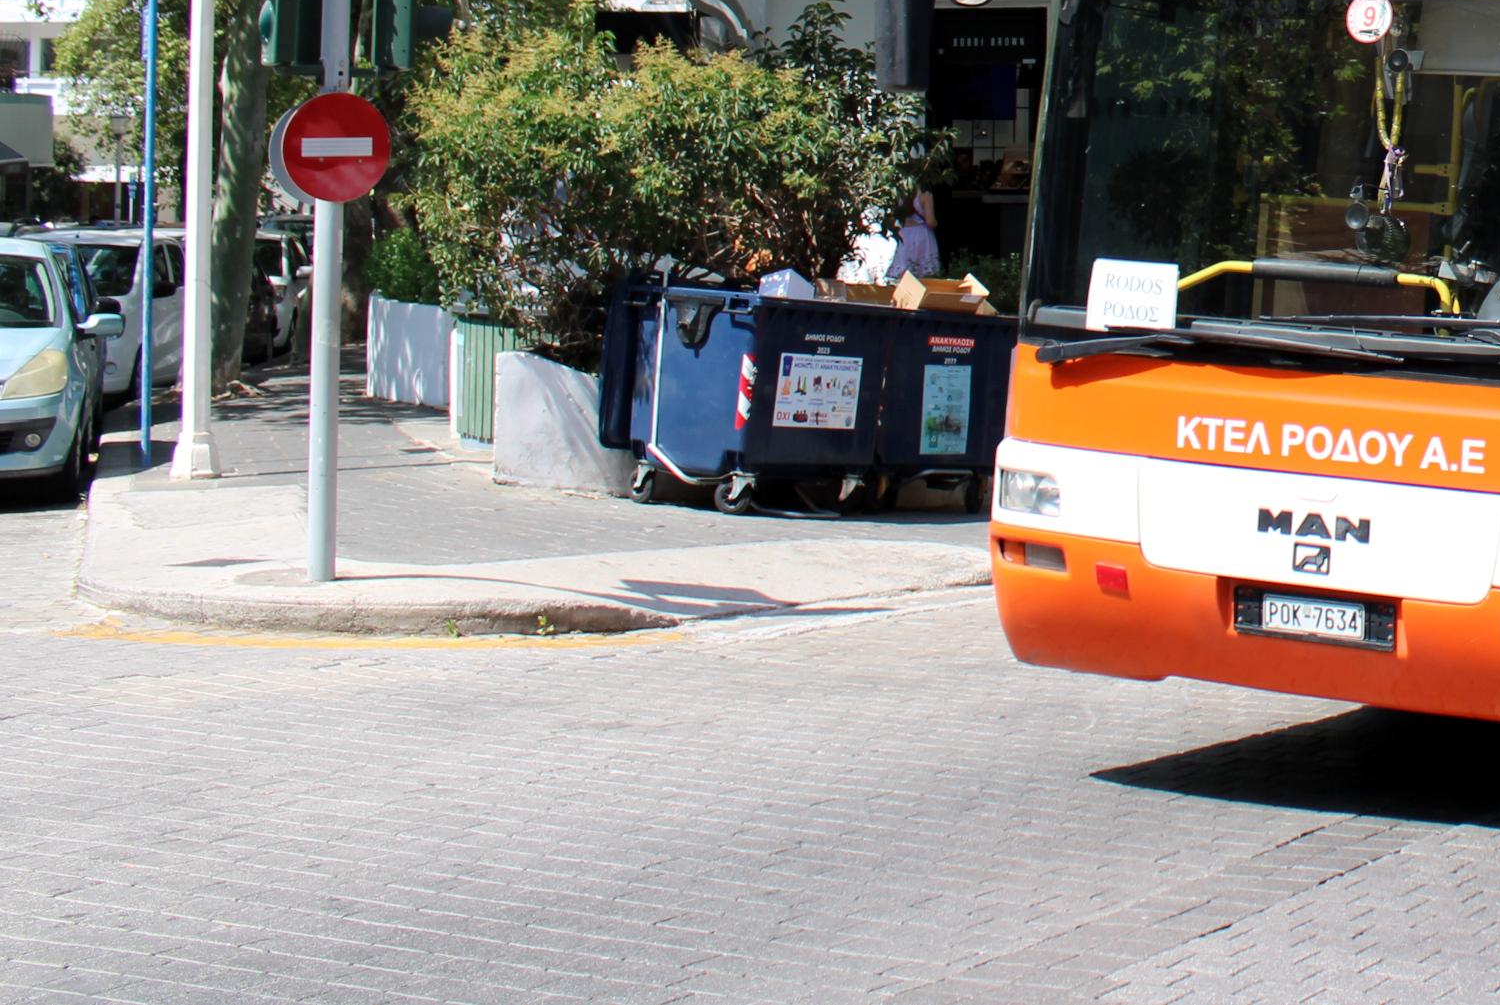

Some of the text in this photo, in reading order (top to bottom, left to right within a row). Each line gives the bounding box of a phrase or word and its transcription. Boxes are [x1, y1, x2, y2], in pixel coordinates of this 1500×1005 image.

[1363, 6, 1376, 27] 9
[953, 37, 1025, 47] BOBBI BROWN
[1105, 273, 1163, 295] RODOS
[1103, 300, 1159, 323] ΡΟΔΟΣ
[826, 334, 845, 343] ΡΟΔΟΥ
[1176, 416, 1486, 474] ΚΤΕΛ ΡΟΔΟΥ Α.Ε
[1257, 508, 1371, 544] MAN
